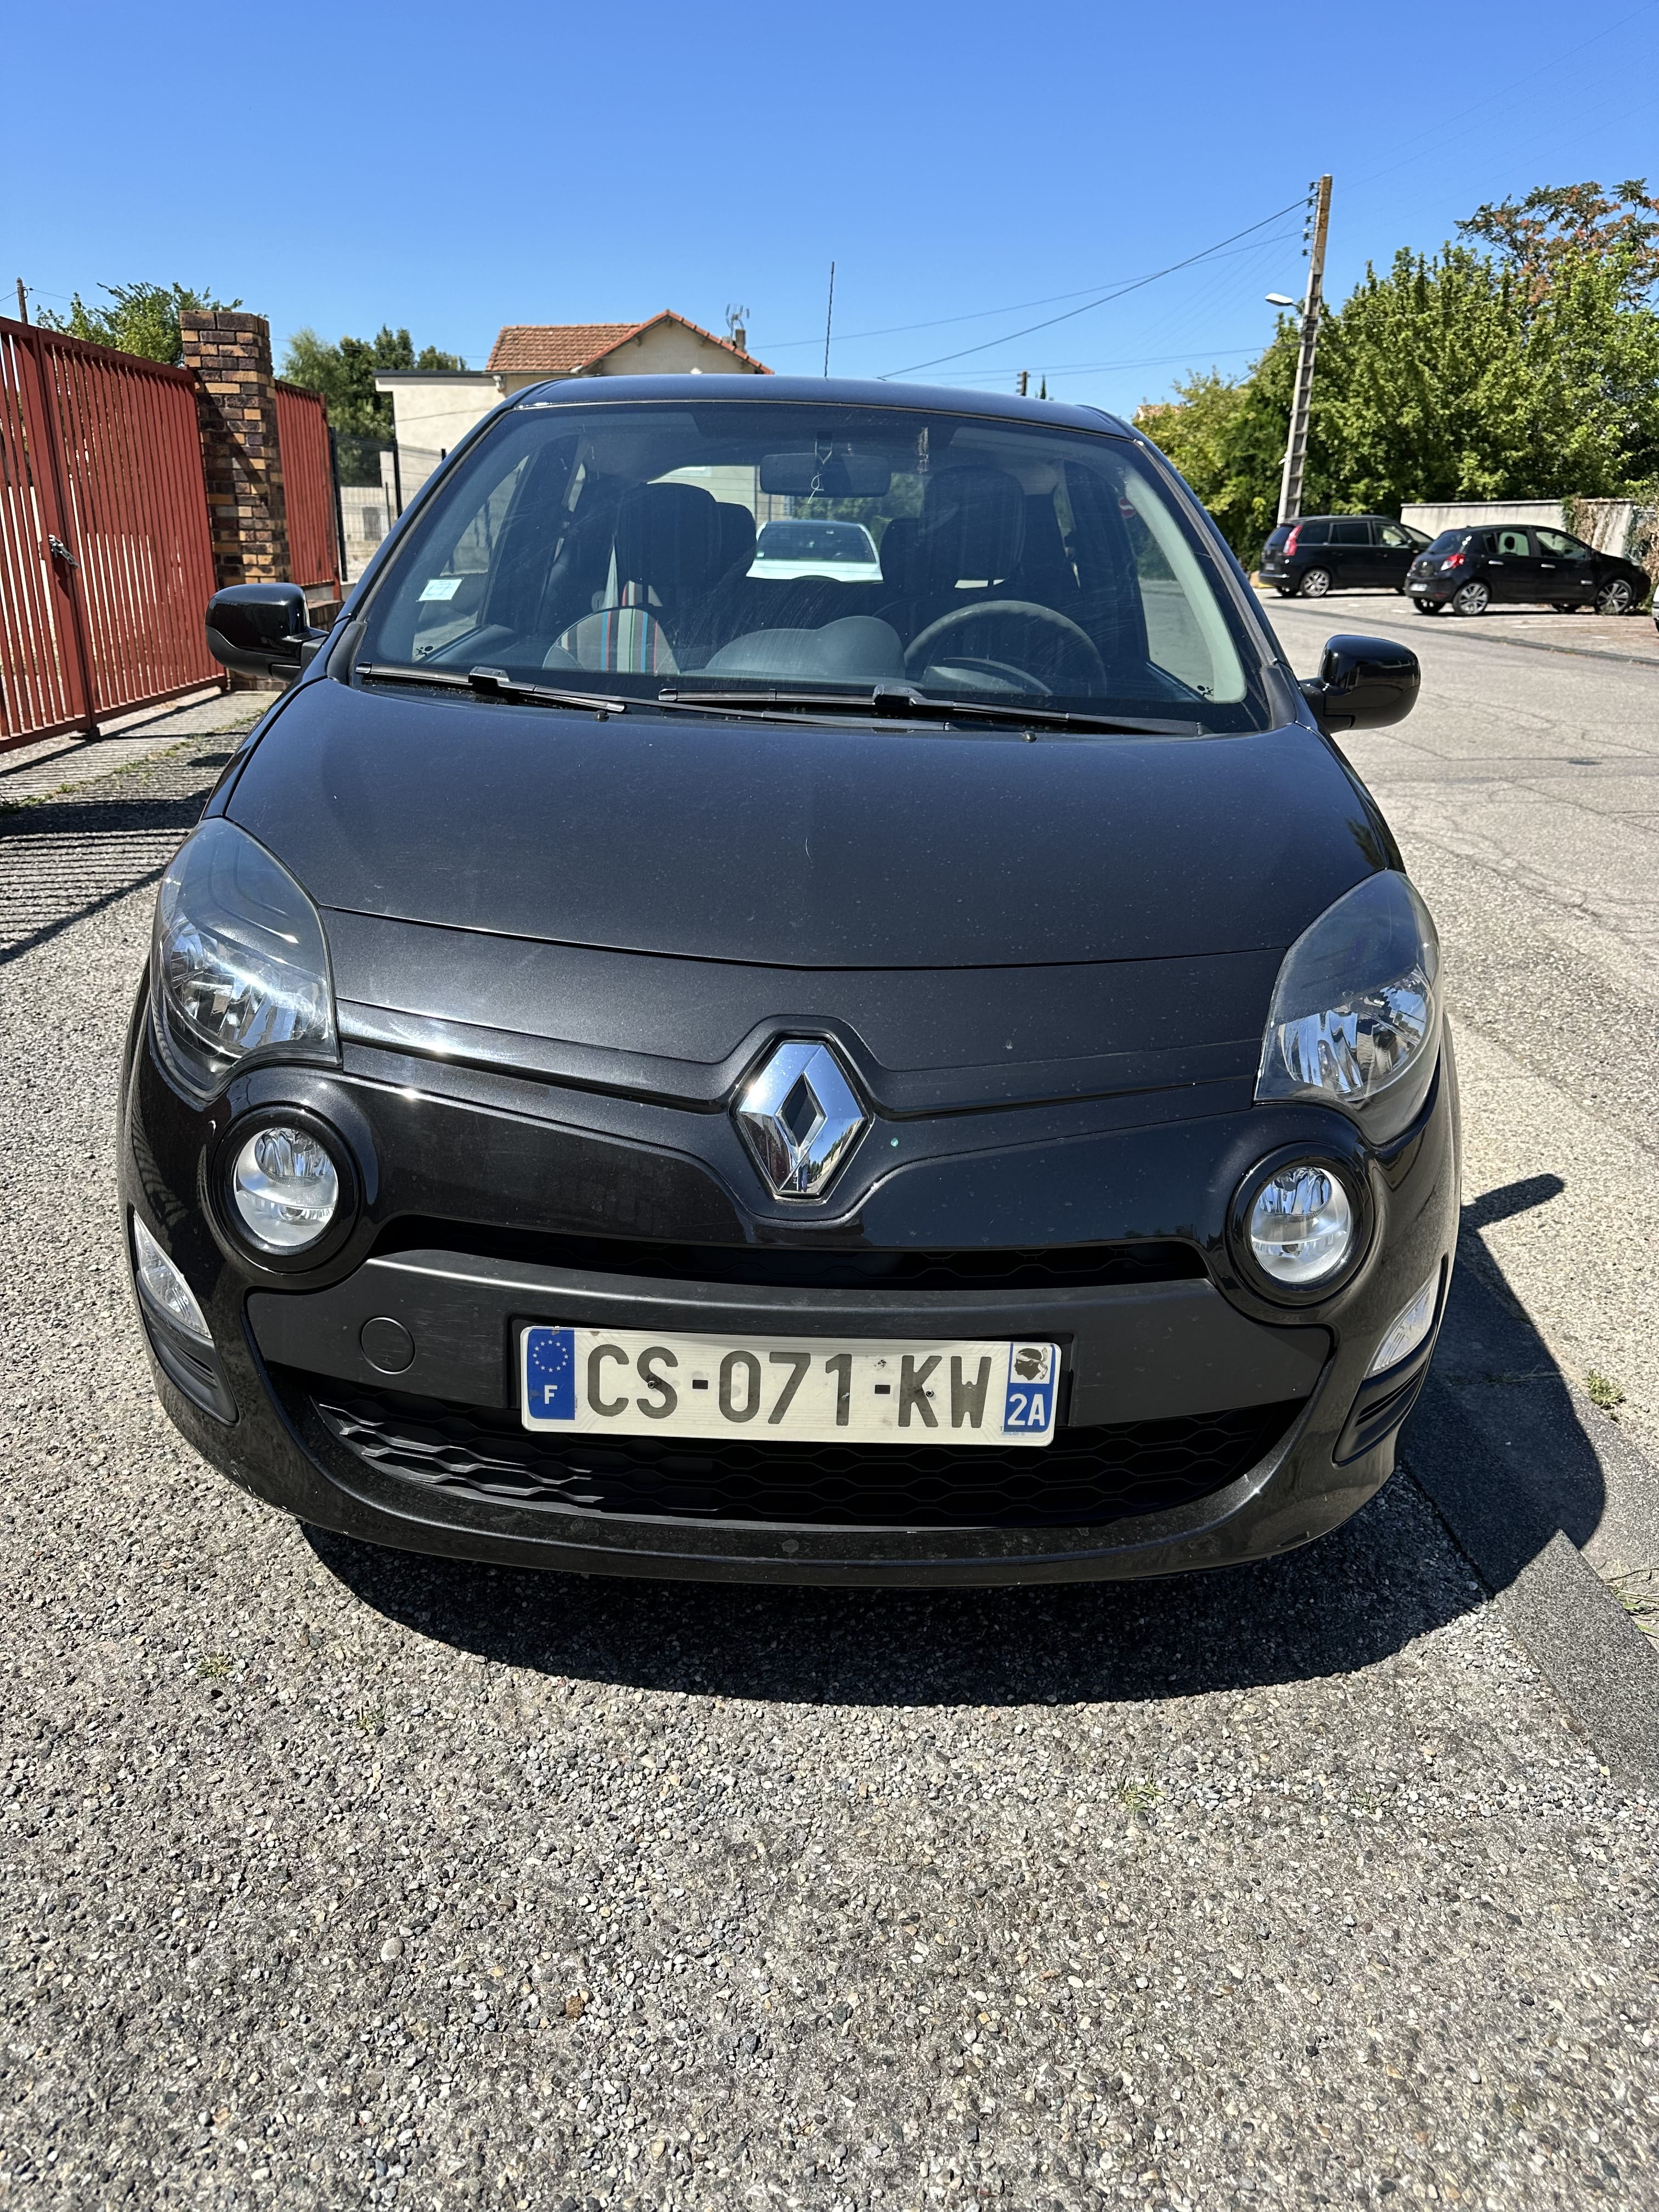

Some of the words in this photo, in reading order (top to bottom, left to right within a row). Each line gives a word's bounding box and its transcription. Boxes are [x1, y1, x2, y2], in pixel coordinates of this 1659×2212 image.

[544, 1385, 558, 1404] F
[588, 1344, 992, 1428] CS-071-KW
[1007, 1393, 1045, 1426] 2A
